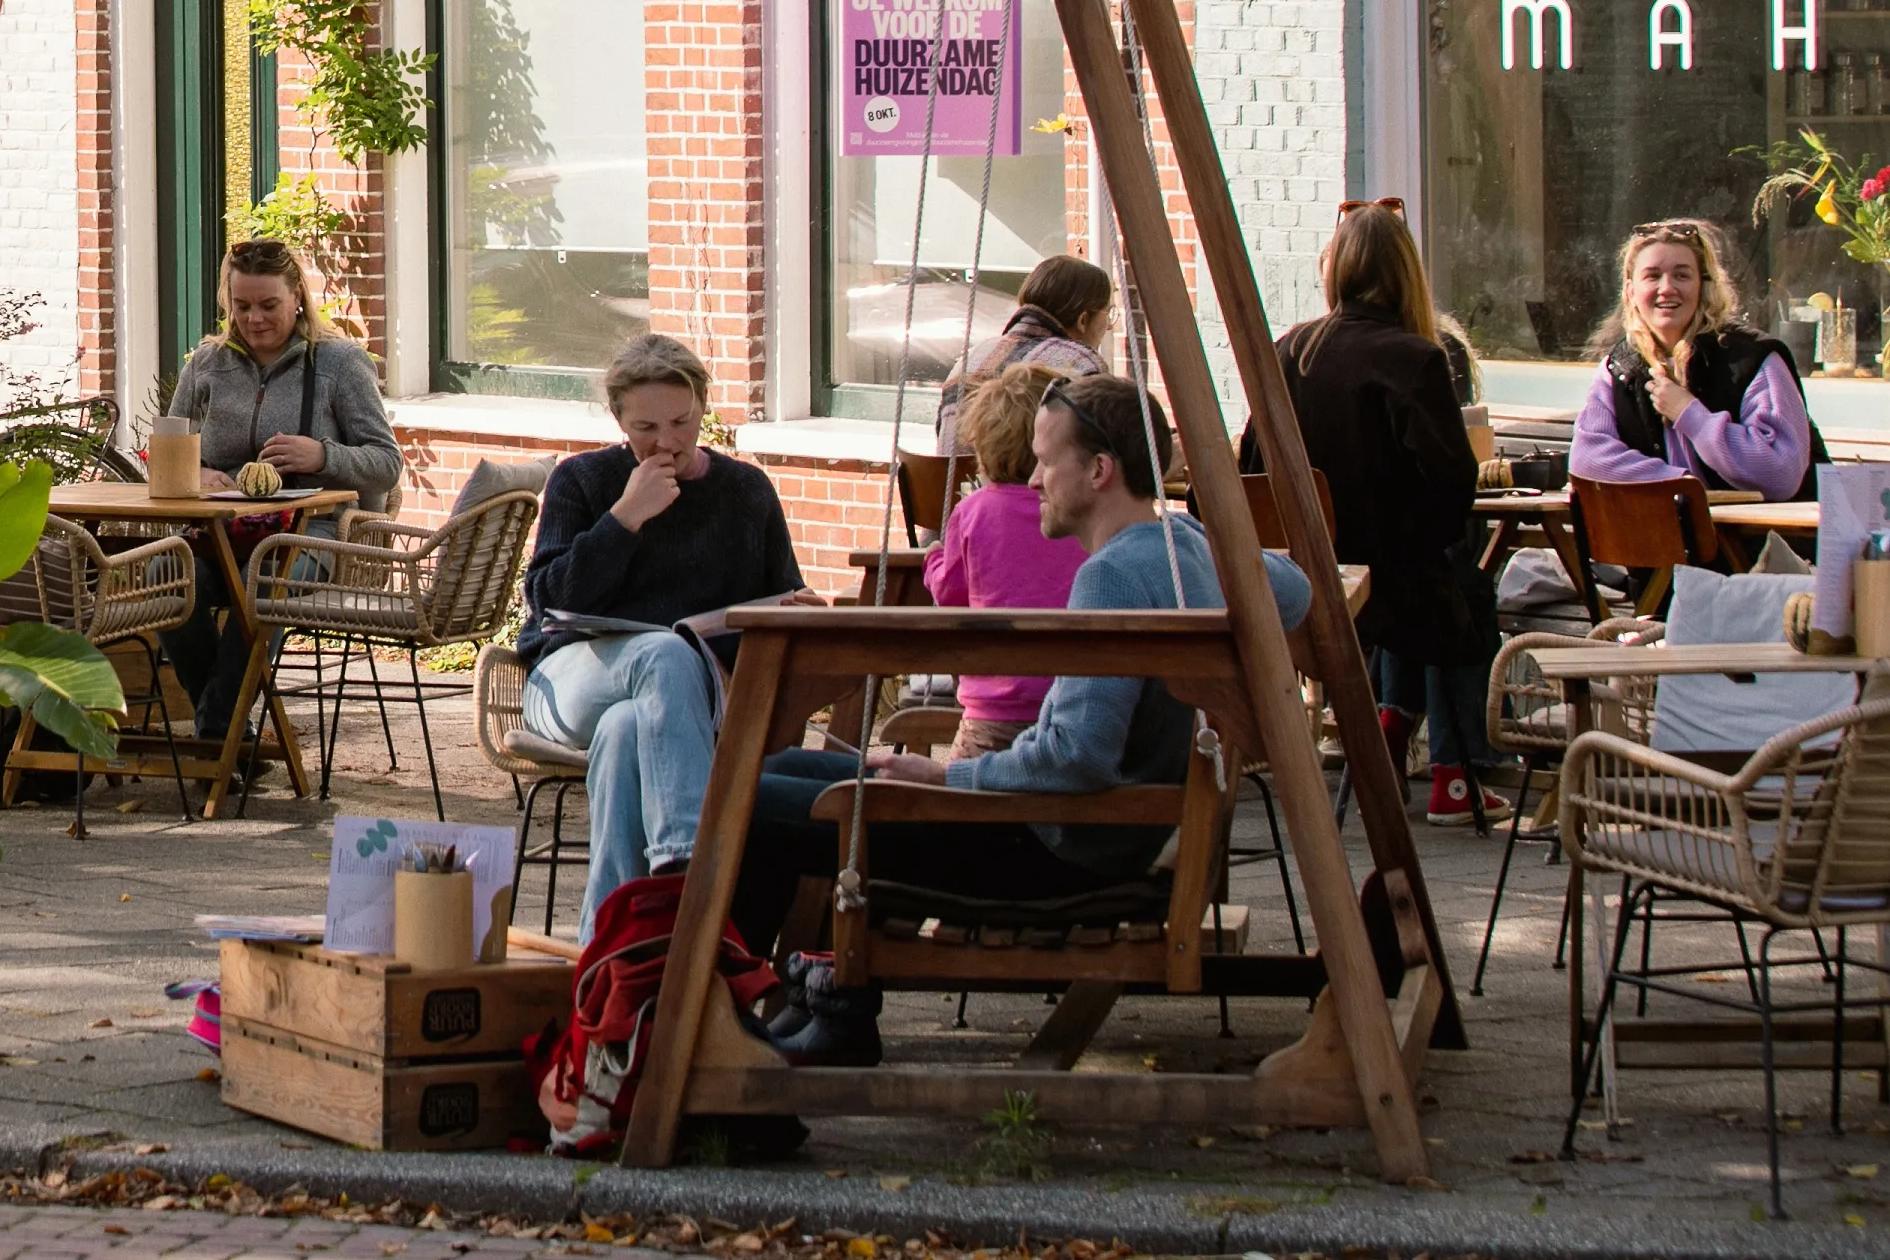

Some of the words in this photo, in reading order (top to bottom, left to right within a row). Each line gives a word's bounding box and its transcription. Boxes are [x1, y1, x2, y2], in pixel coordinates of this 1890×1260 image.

[949, 11, 983, 40] DE
[854, 39, 1000, 68] DUURZAME
[854, 68, 999, 96] HUIZENDAG
[868, 111, 875, 122] 8
[876, 107, 897, 120] OKT.
